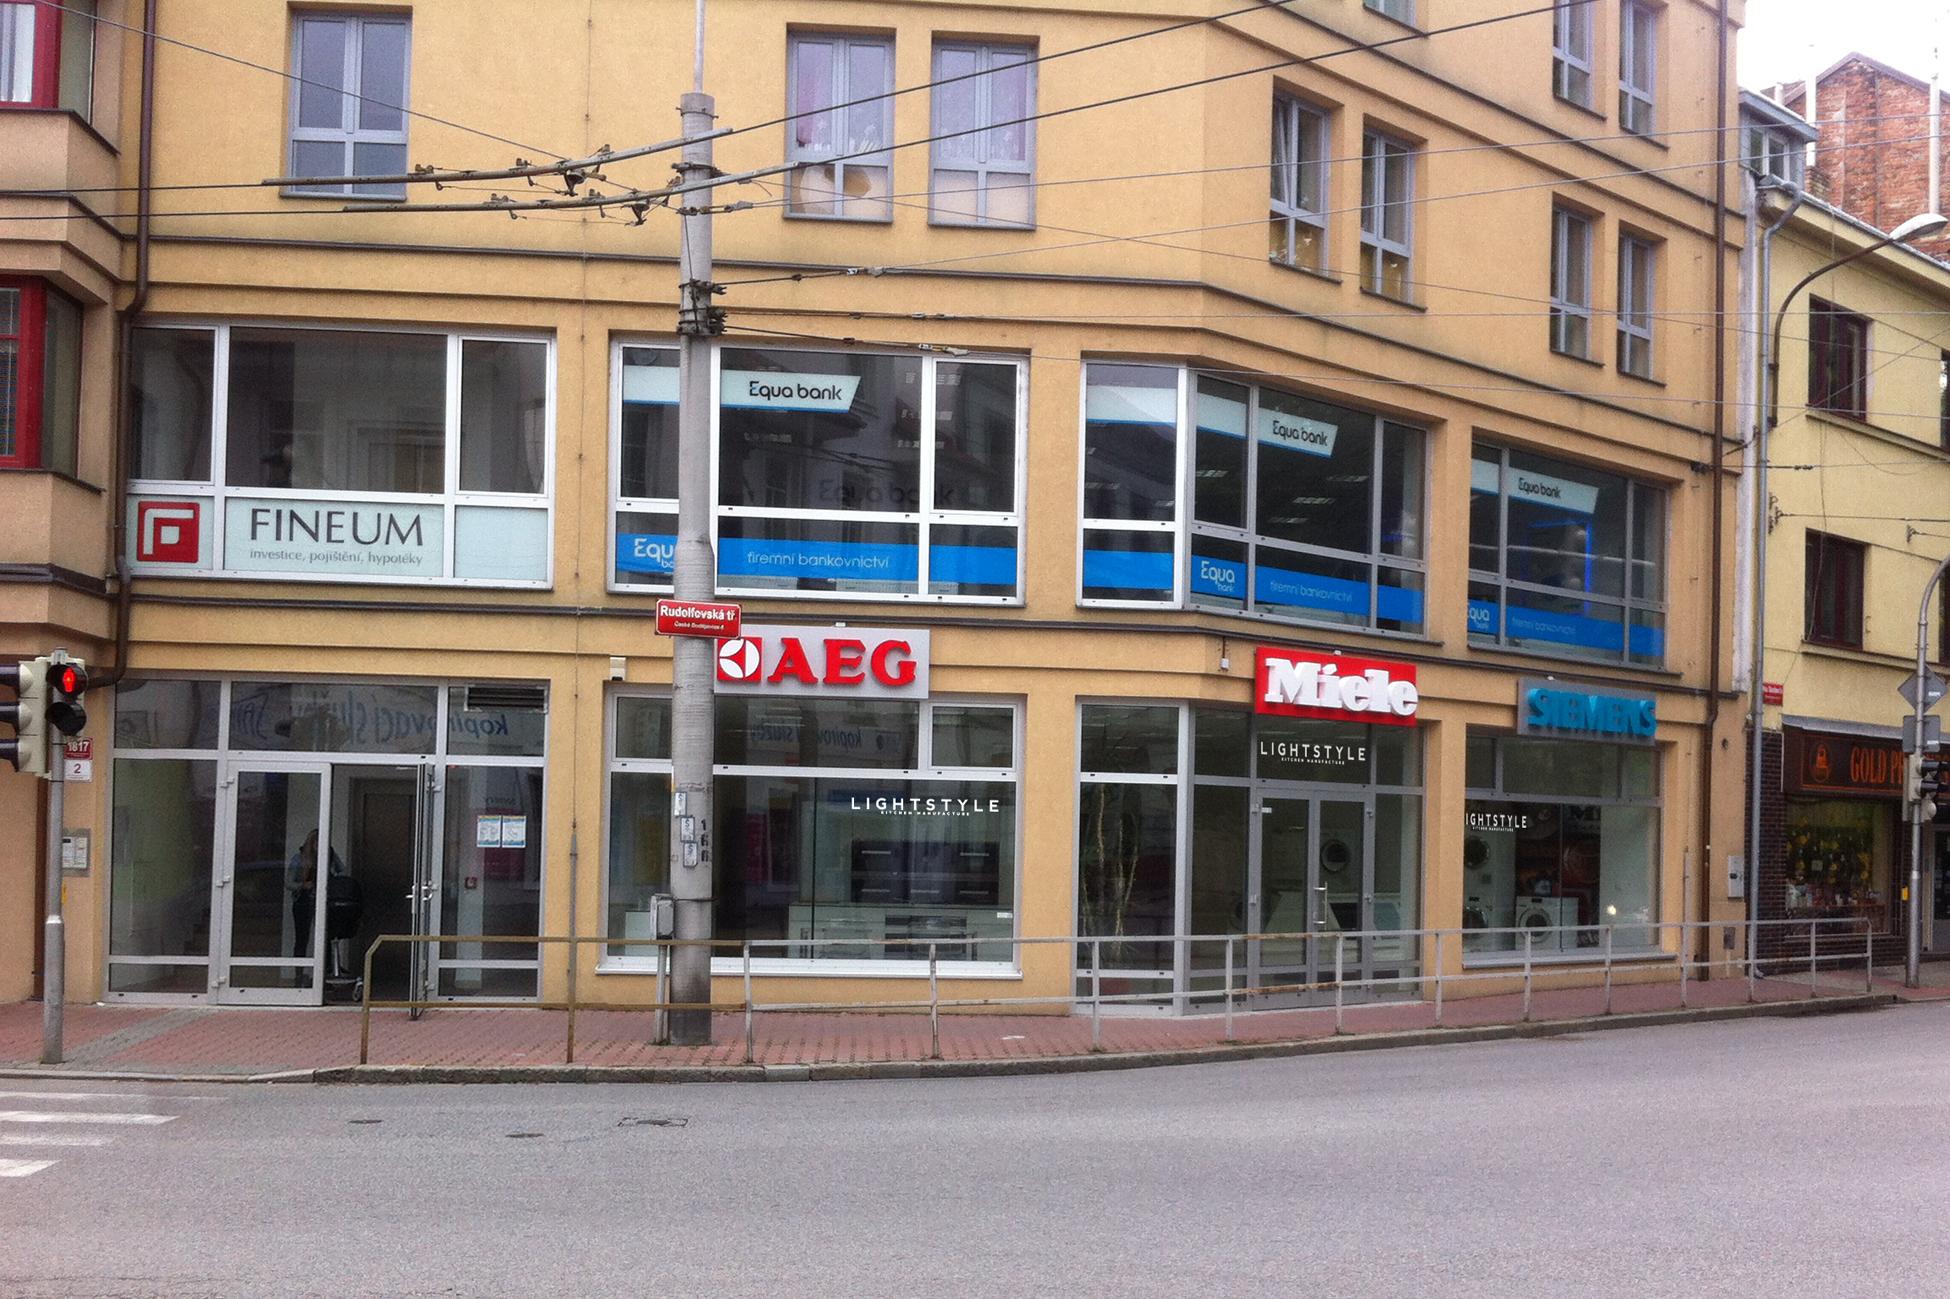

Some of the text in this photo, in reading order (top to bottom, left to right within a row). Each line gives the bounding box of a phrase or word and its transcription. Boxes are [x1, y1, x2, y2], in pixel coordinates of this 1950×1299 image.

[749, 380, 843, 401] Equa bank
[1272, 420, 1328, 447] Equa bank
[1518, 477, 1562, 500] Equa bank
[250, 508, 423, 546] FINEUM
[250, 549, 423, 567] investice, pojištění, hypotéky
[634, 537, 674, 562] Equ
[747, 551, 889, 570] firemní bankovnictví
[1201, 560, 1235, 585] Equa
[660, 605, 724, 621] Rudolfovská
[1468, 605, 1490, 624] qua
[767, 637, 917, 687] AEG
[1264, 657, 1419, 716] Miele
[1526, 687, 1657, 737] SIEMENS
[67, 741, 90, 752] 1817
[1260, 741, 1366, 761] LIGHTSTYLE
[74, 763, 82, 774] 2
[1851, 746, 1888, 785] GOLD
[851, 797, 1000, 813] LIGHTSTYLE
[1465, 812, 1528, 829] IGHTSTYLE
